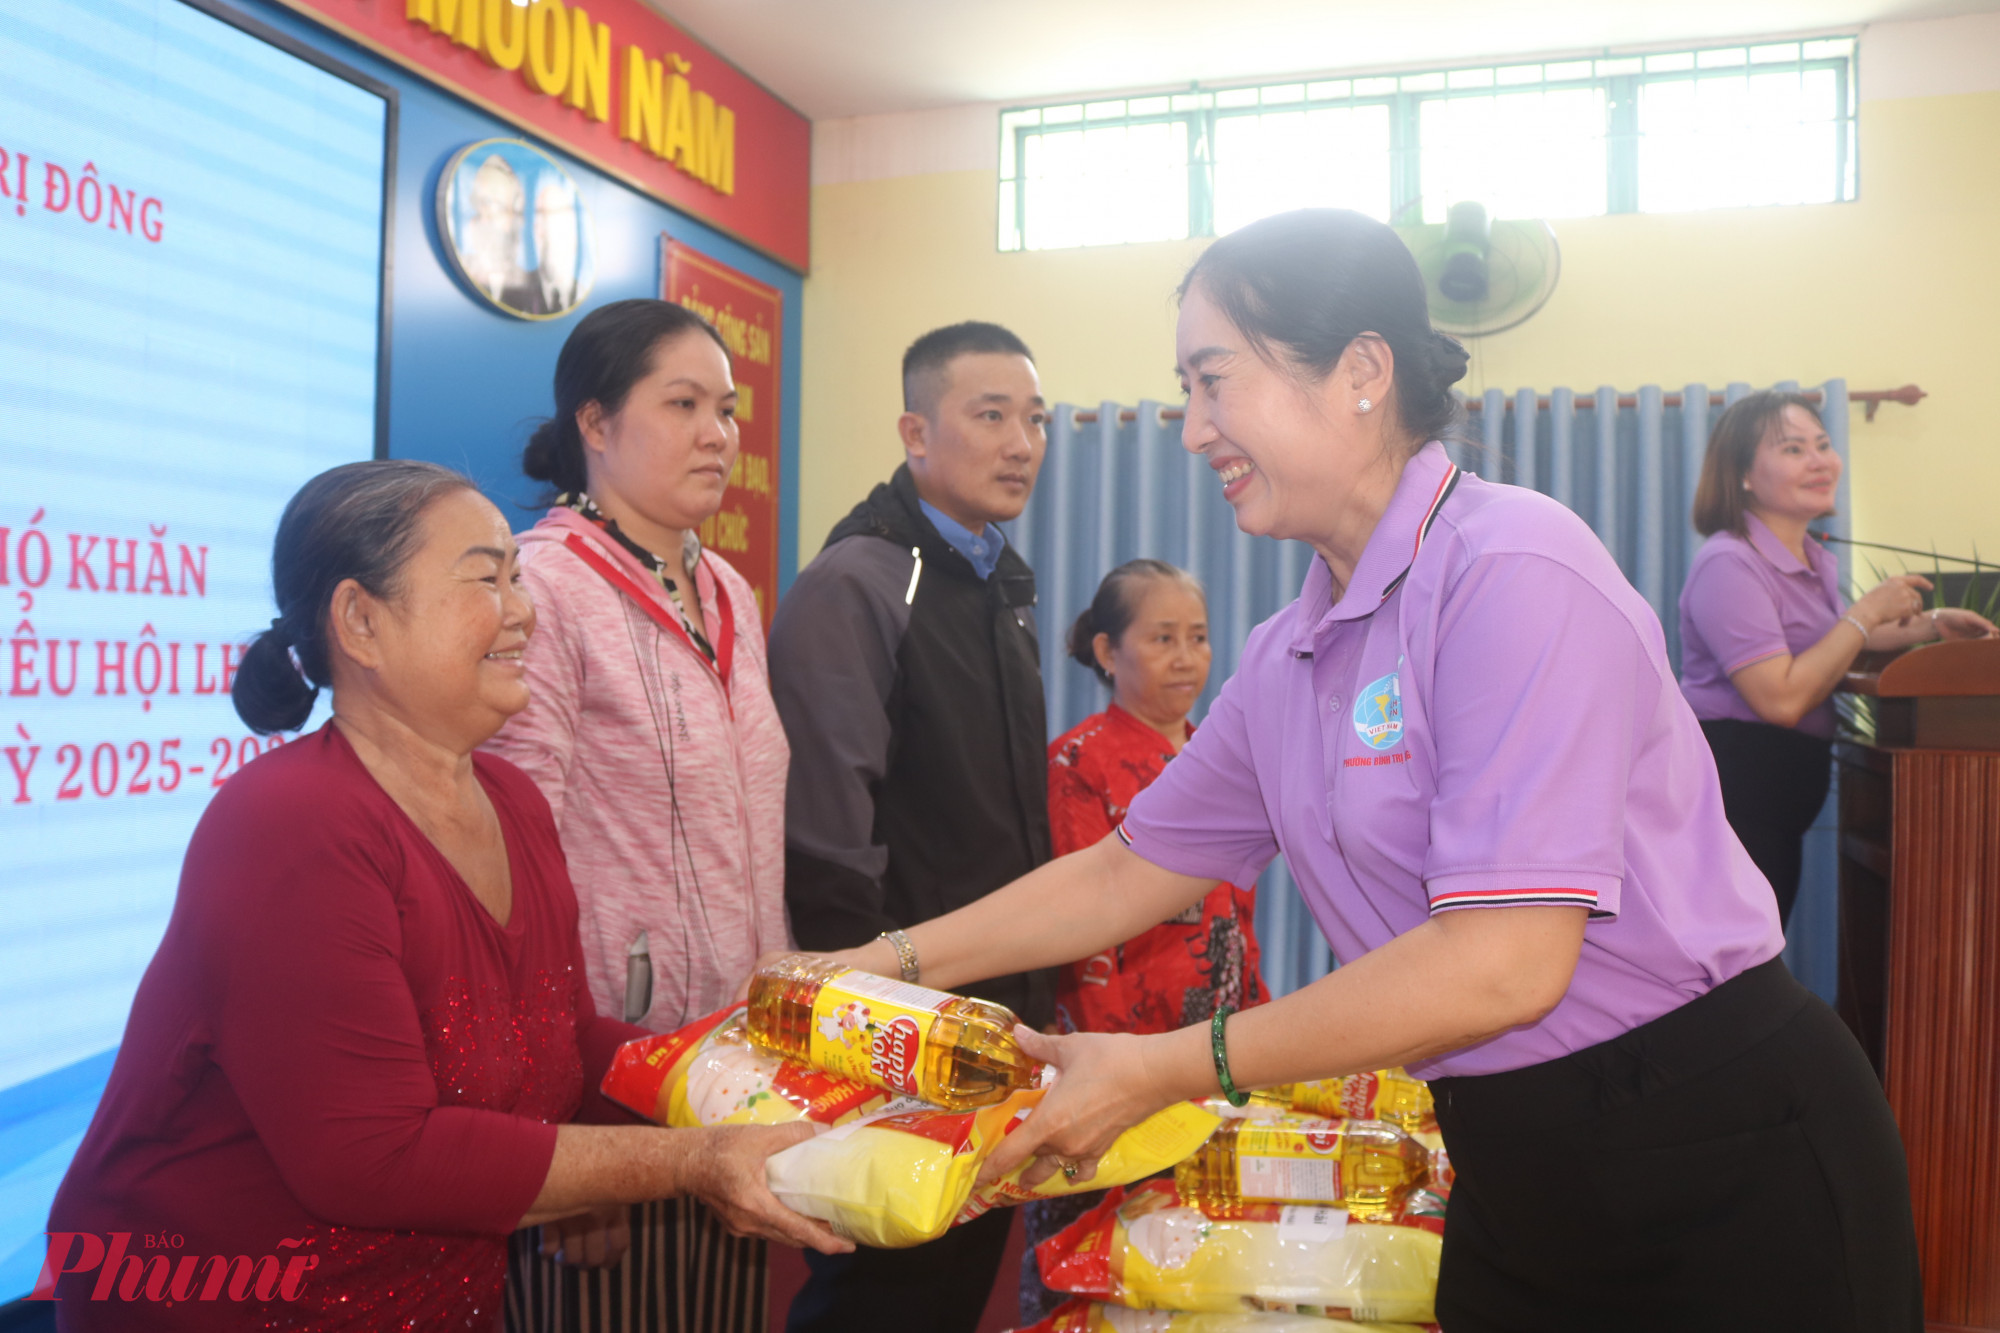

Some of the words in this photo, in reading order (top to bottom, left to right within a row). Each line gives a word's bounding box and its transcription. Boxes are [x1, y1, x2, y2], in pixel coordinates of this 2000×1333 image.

[620, 46, 735, 196] NĂM
[43, 160, 164, 243] ĐÔNG
[67, 522, 209, 598] KHĂN
[0, 590, 81, 696] ỂU
[94, 622, 181, 712] HỘI
[0, 722, 41, 804] Ỳ
[55, 733, 306, 800] 2025-20
[870, 1020, 893, 1079] Koki
[888, 1022, 913, 1094] happi
